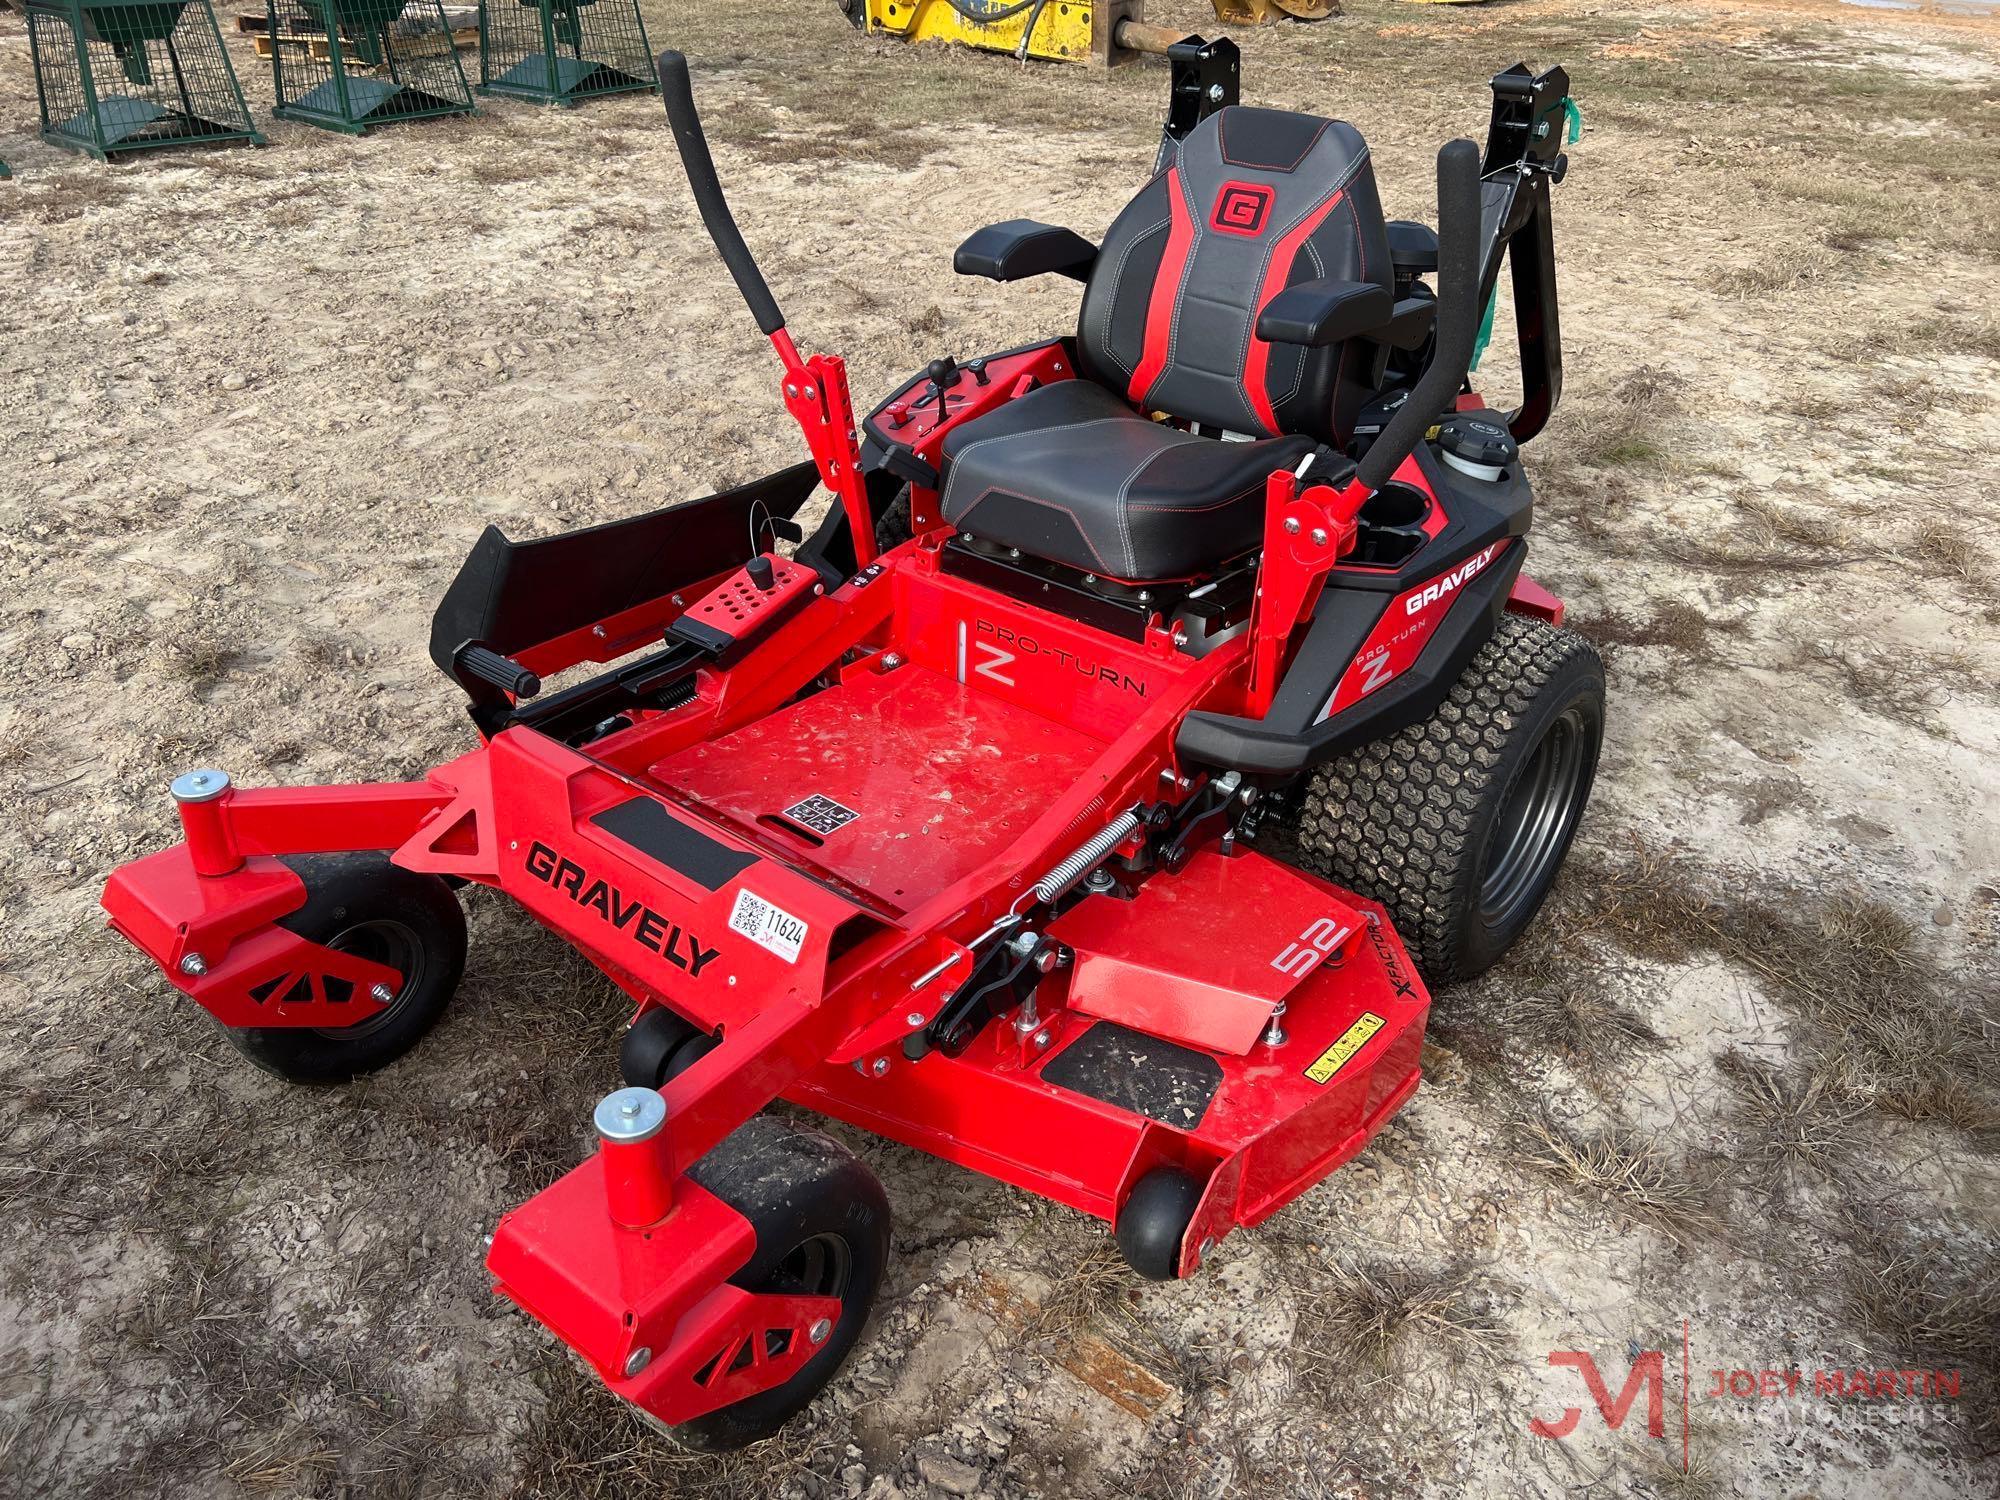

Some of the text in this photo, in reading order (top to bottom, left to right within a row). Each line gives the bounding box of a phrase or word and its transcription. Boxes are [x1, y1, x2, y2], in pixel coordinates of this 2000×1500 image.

[1216, 188, 1268, 230] G
[1406, 544, 1496, 616] GRAVELY
[975, 640, 1016, 687] Z
[976, 619, 1148, 698] PRO-TURN
[1356, 619, 1426, 666] PRO-TURN
[1360, 651, 1393, 694] Z
[525, 840, 721, 978] GRAVELY
[767, 909, 803, 945] 11624
[1269, 918, 1350, 978] 52
